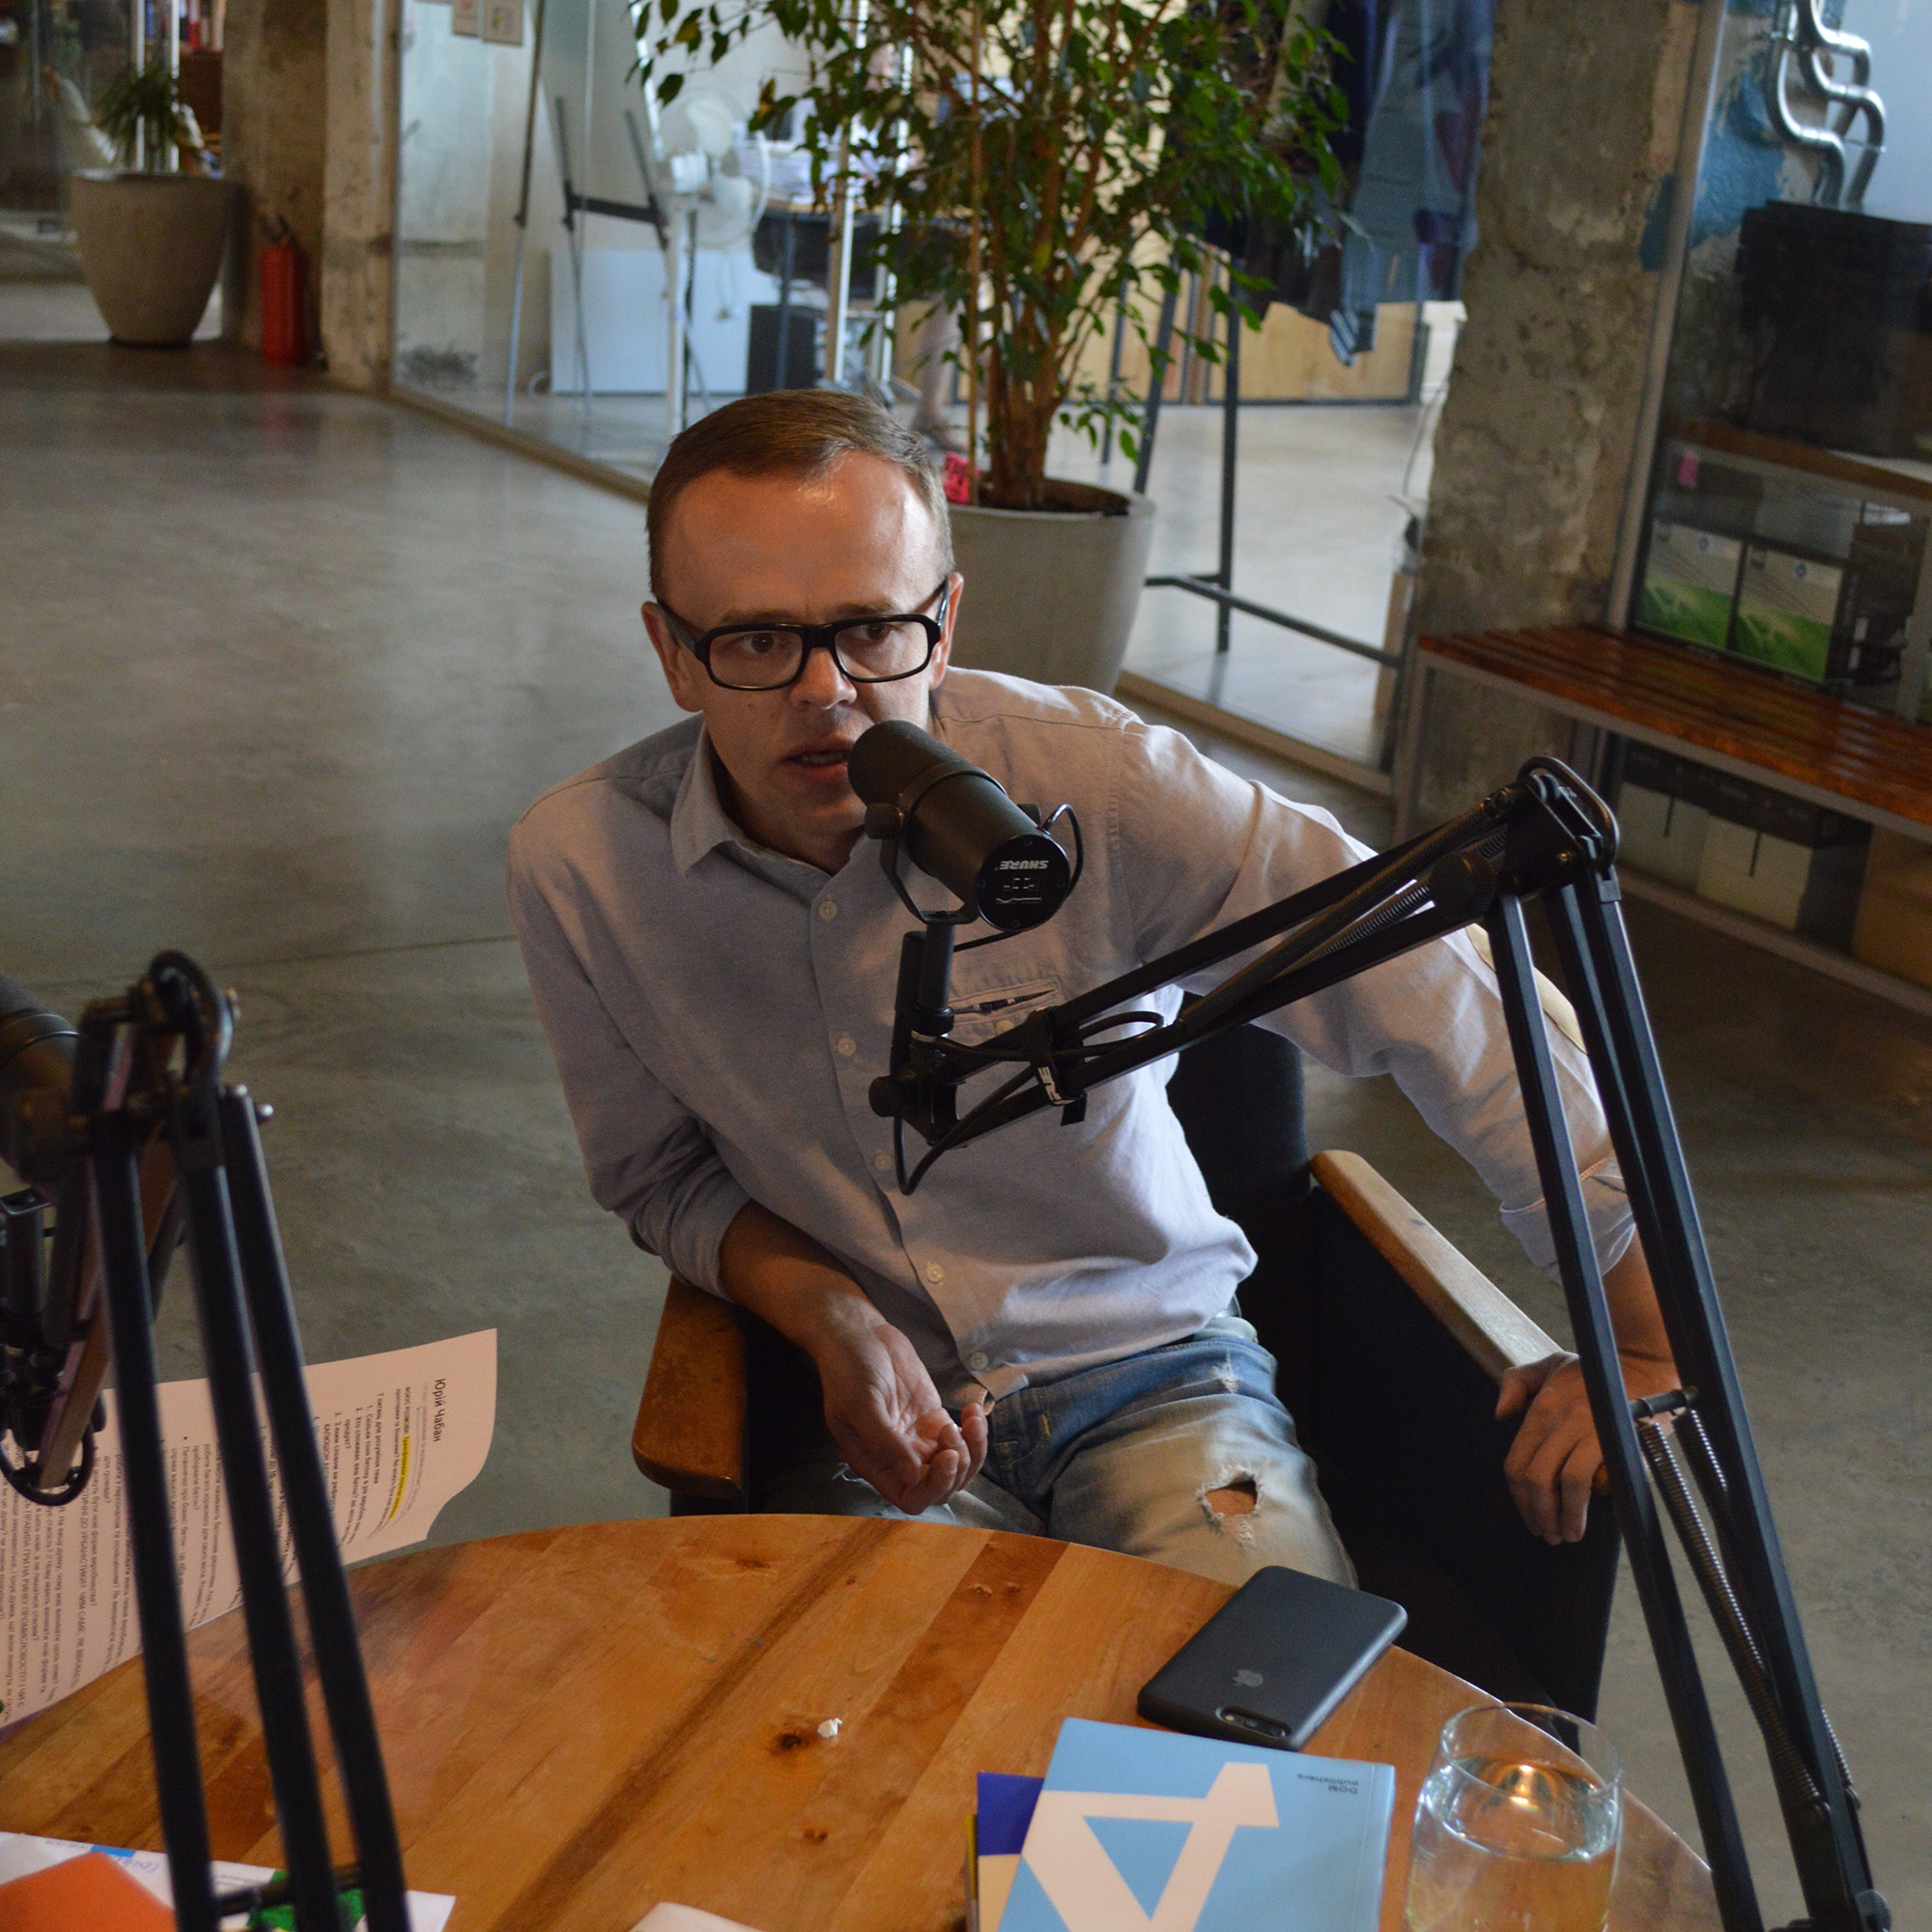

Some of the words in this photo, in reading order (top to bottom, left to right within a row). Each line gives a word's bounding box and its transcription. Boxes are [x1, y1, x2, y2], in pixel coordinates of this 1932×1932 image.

[1000, 860, 1049, 870] SHURE
[432, 1378, 446, 1406] Юрій
[433, 1408, 445, 1442] Чабан
[362, 1457, 371, 1479] бетону
[1328, 1784, 1358, 1794] DOM
